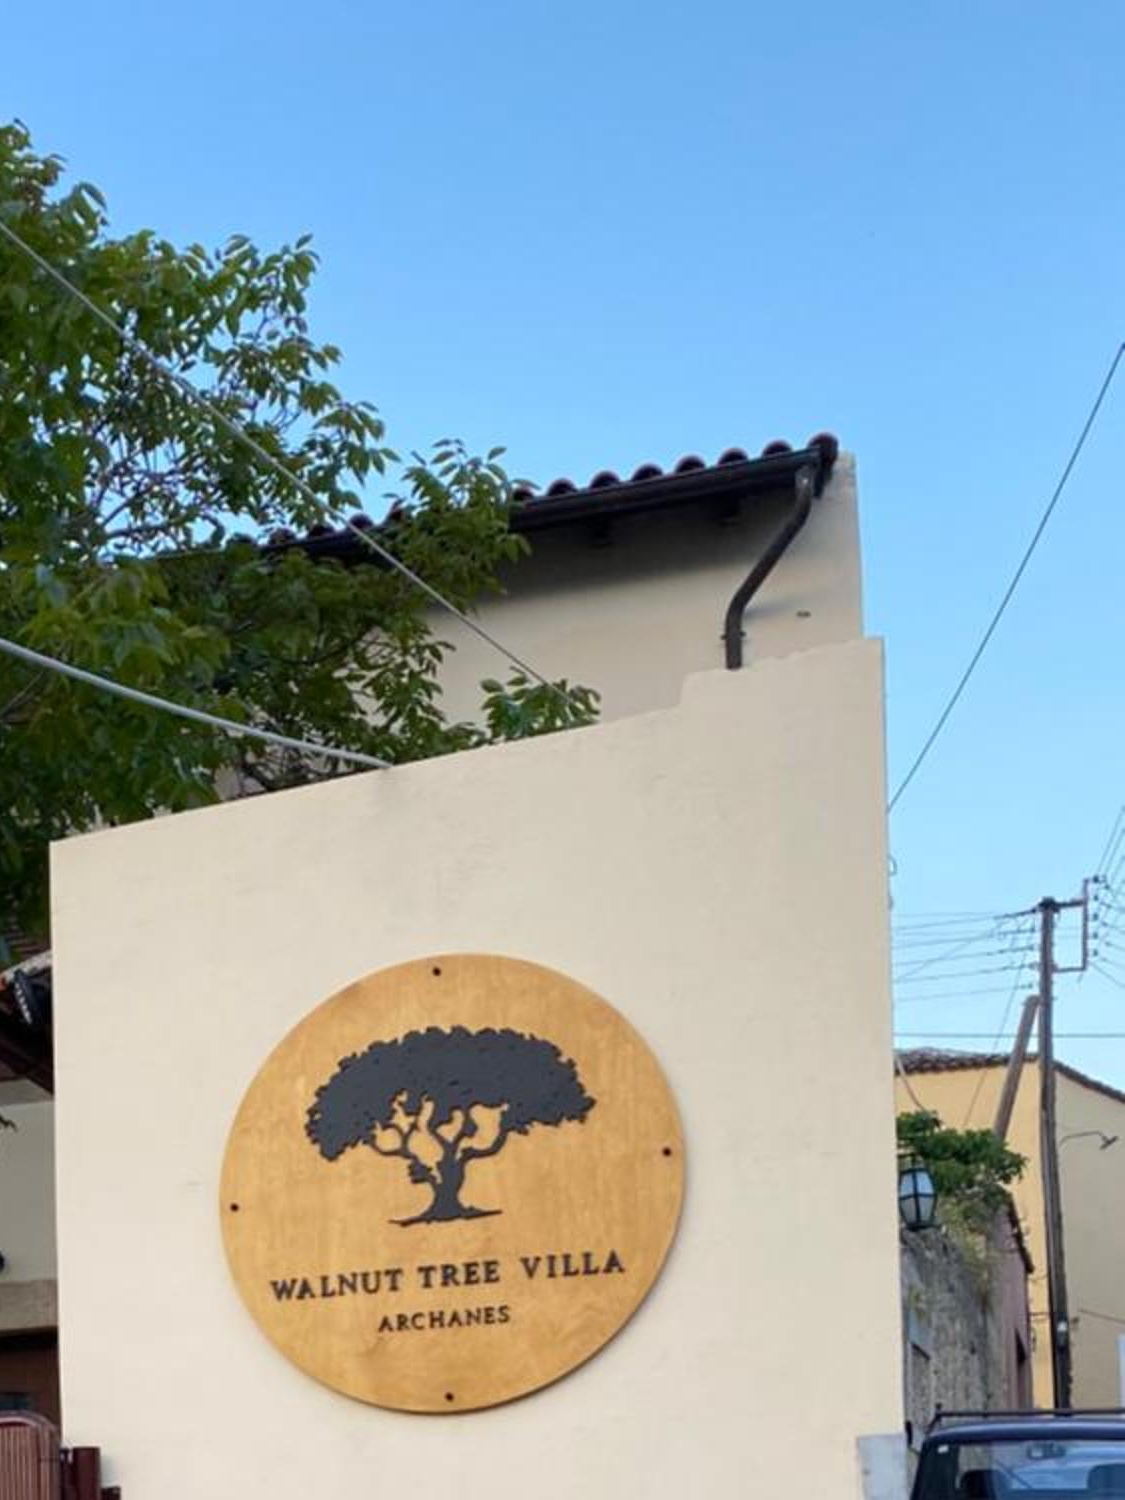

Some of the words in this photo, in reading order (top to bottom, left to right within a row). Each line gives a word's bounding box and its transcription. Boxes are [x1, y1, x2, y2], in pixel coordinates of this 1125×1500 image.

[271, 1268, 403, 1301] WALNUT
[418, 1260, 501, 1290] TREE
[520, 1250, 626, 1280] VILLA
[378, 1305, 511, 1332] ARCHANES
